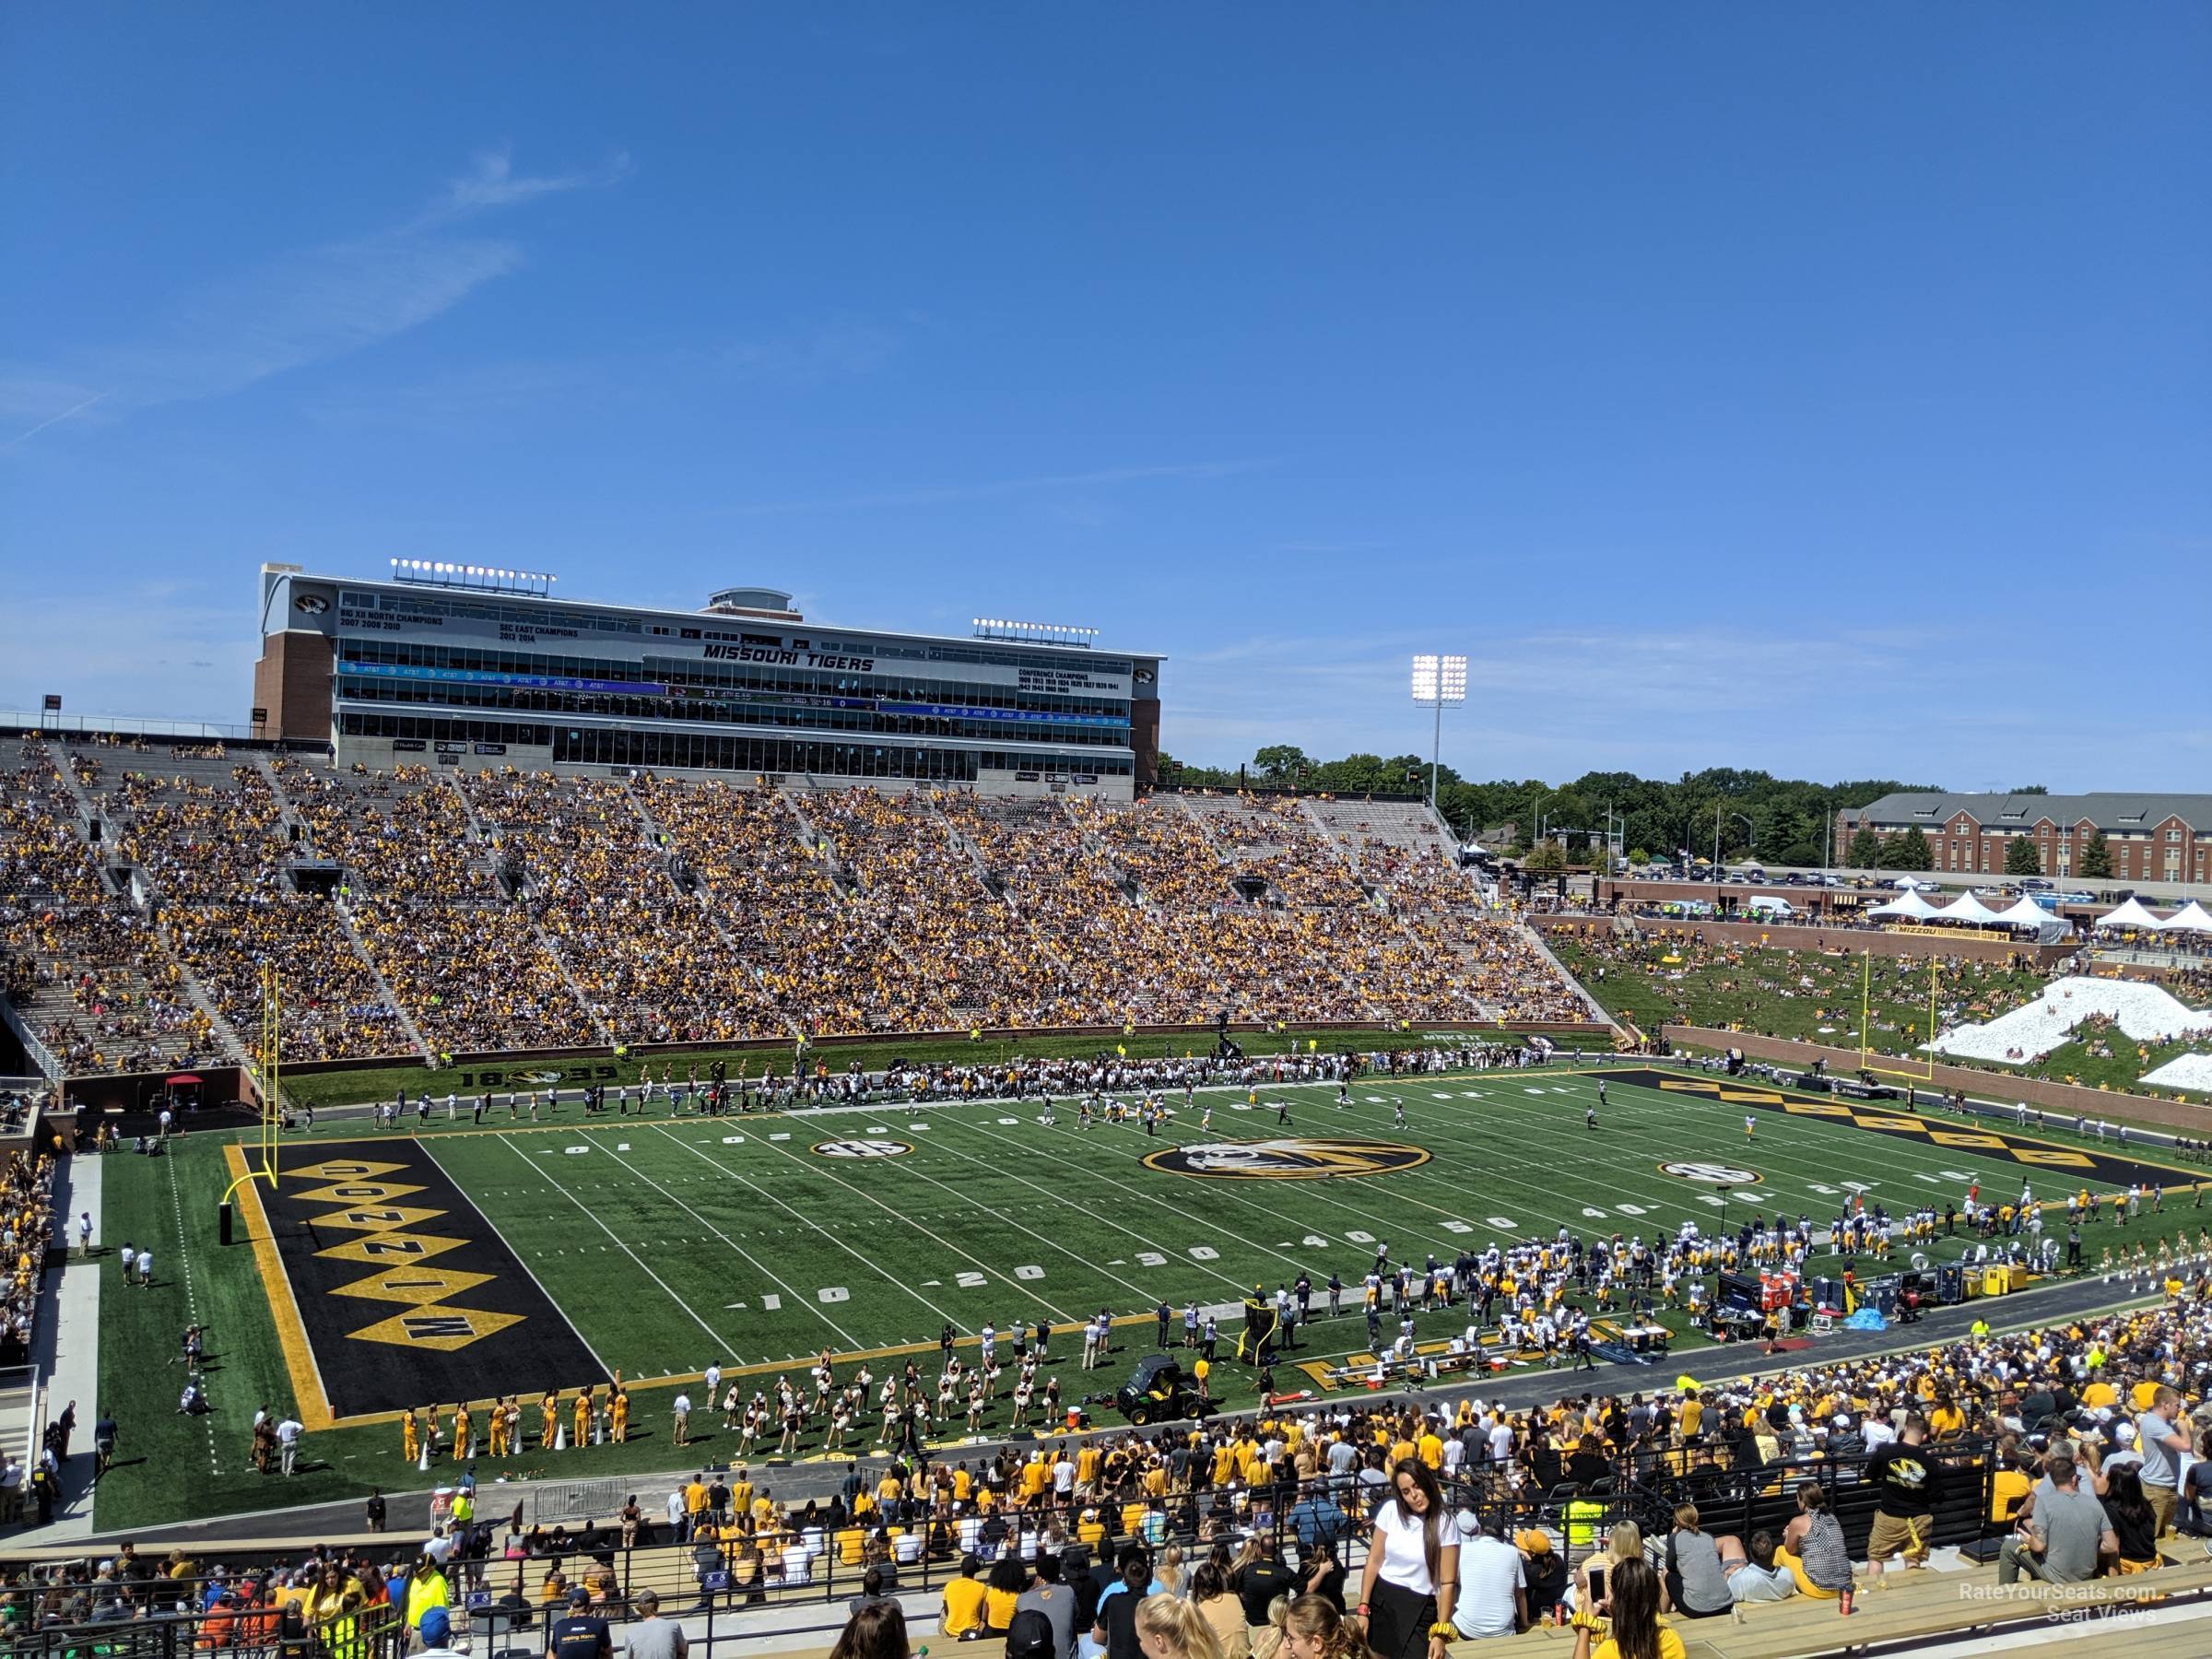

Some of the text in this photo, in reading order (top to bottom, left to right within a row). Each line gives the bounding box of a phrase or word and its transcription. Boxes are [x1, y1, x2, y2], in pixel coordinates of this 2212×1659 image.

[340, 609, 443, 626] BIG XII NORTH CHAMPIONS
[340, 618, 359, 627] 2007
[383, 621, 401, 630] 2010
[500, 623, 579, 638] SEC EAST CHAMPIONS
[518, 633, 535, 642] 2014
[703, 645, 875, 672] MISSOURI TIGERS
[1018, 668, 1088, 681] CONFERENCE CHAMPIONS
[1899, 926, 1936, 935] MIZZOU
[461, 1066, 618, 1087] 18 39
[1438, 1217, 1519, 1234] 50
[1301, 1230, 1377, 1248] 40
[320, 1166, 479, 1341] MIZZOU
[1135, 1246, 1221, 1267] 30
[954, 1265, 1047, 1288] 20
[760, 1287, 851, 1311] 10
[1775, 1293, 1783, 1303] G
[740, 1487, 745, 1499] 1
